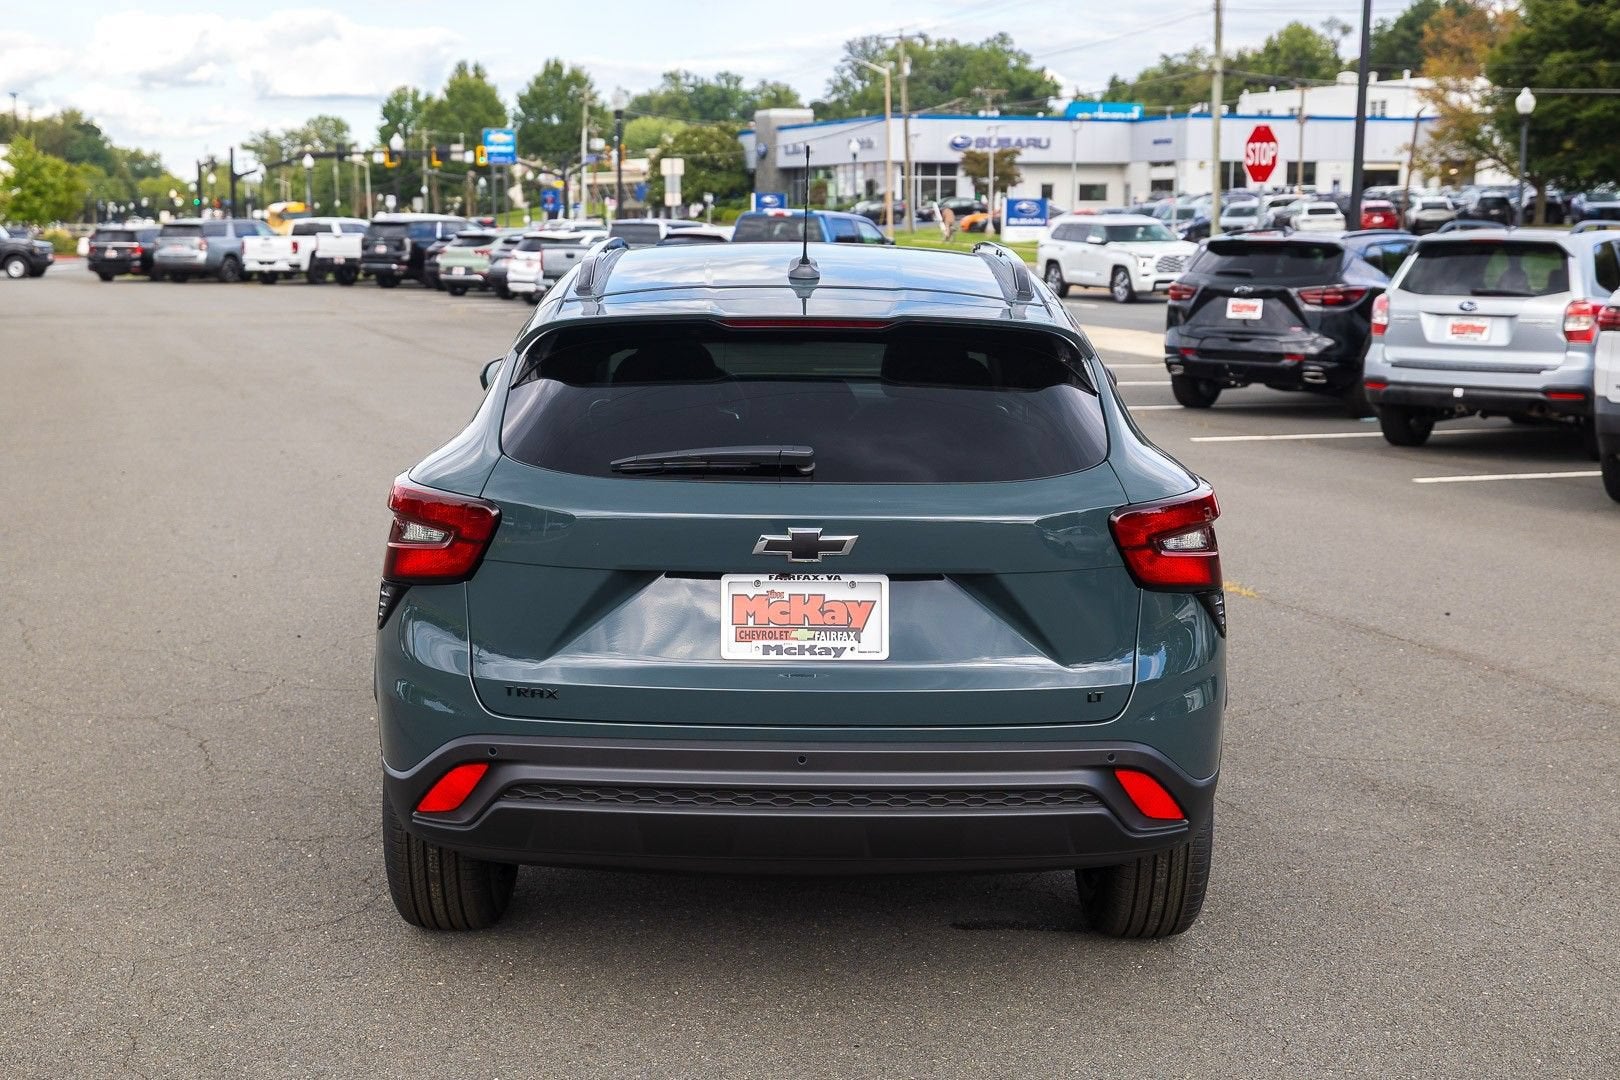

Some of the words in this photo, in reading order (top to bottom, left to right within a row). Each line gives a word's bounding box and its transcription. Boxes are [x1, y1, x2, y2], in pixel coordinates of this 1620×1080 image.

[975, 137, 1051, 149] SUBARU
[1246, 141, 1277, 167] STOP
[732, 593, 876, 633] McKay
[738, 630, 789, 641] CHEVROLET
[815, 630, 857, 642] FAIRFAX
[762, 644, 847, 658] McKay
[504, 685, 559, 700] TRAX
[1087, 691, 1105, 703] LT
